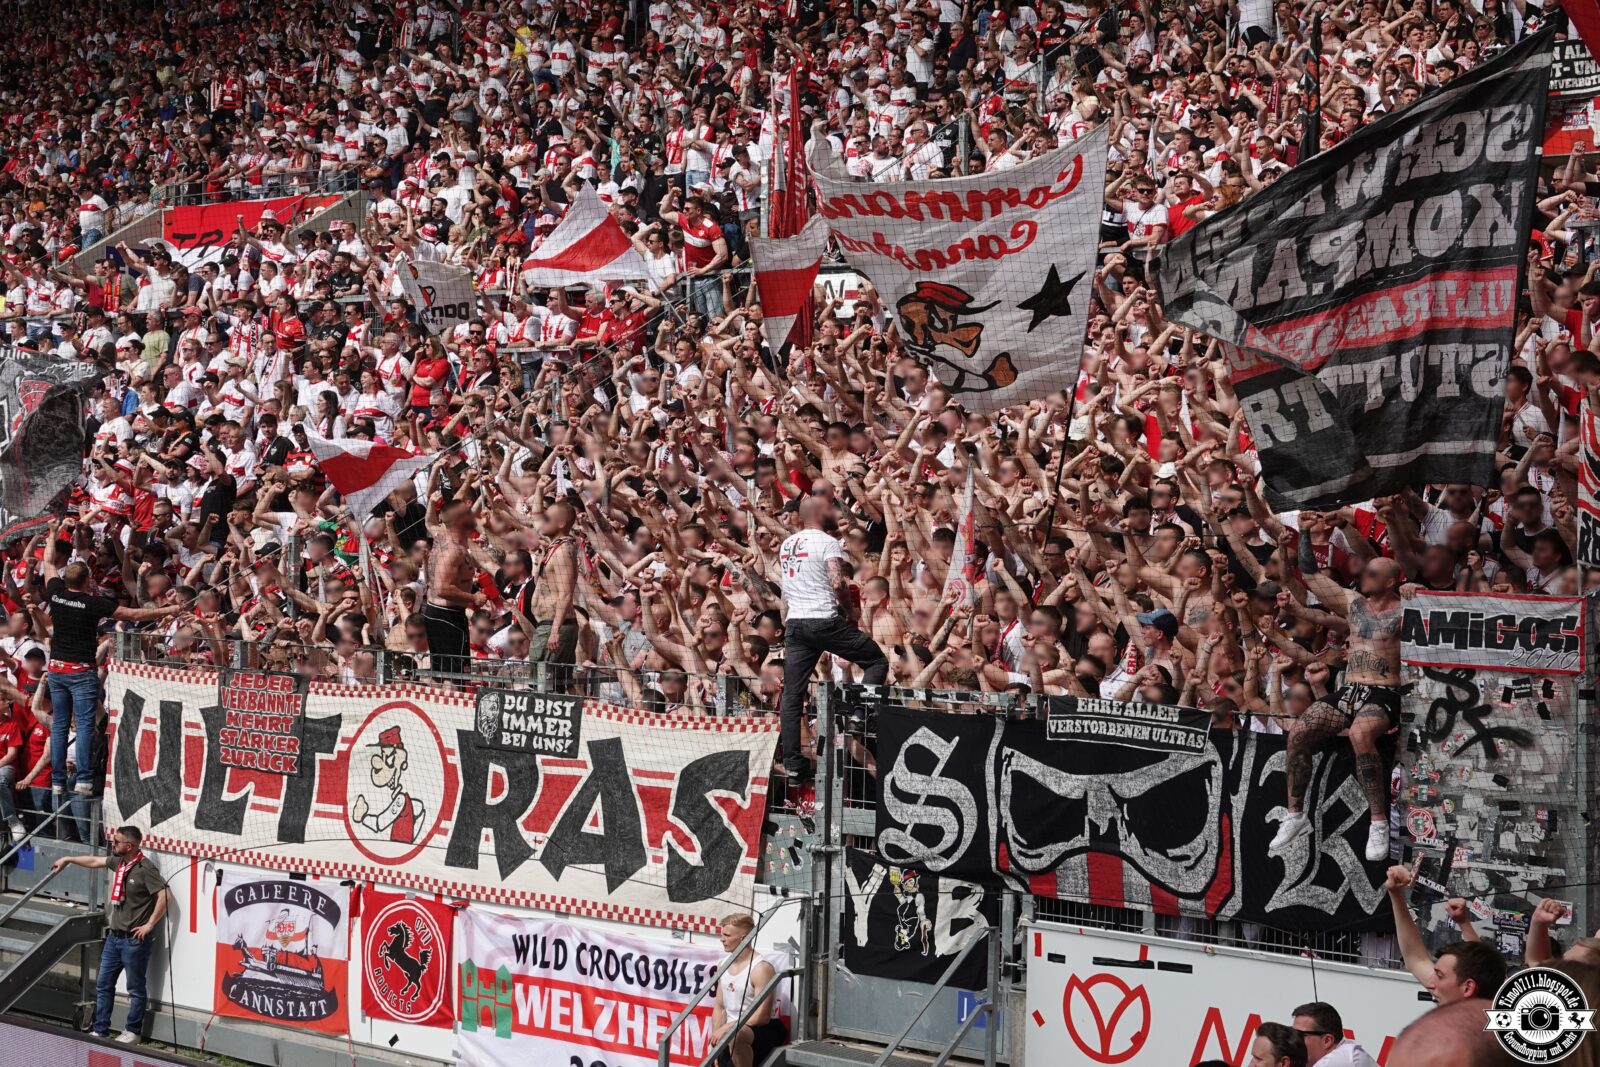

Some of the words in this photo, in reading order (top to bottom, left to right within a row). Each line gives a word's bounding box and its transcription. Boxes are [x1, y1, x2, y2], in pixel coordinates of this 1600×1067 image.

[1506, 647, 1581, 669] 2010
[230, 672, 294, 694] JEDER
[221, 686, 302, 716] VERBANNTE
[504, 695, 528, 712] DU
[534, 698, 575, 717] BIST
[1076, 697, 1123, 716] EHRE
[1123, 701, 1182, 723] ALLEN
[226, 710, 294, 733] KEHRT
[502, 712, 572, 738] IMMER
[1049, 719, 1152, 741] VERSTORBENEN
[1152, 727, 1205, 749] ULTRAS
[502, 732, 527, 747] BEI
[532, 735, 573, 753] UNS!
[235, 884, 327, 915] GALEERE
[511, 933, 568, 971] WILD
[576, 942, 718, 998] CROCODILES
[229, 984, 327, 1017] CANNSTATT
[514, 982, 713, 1058] WELZHEIM
